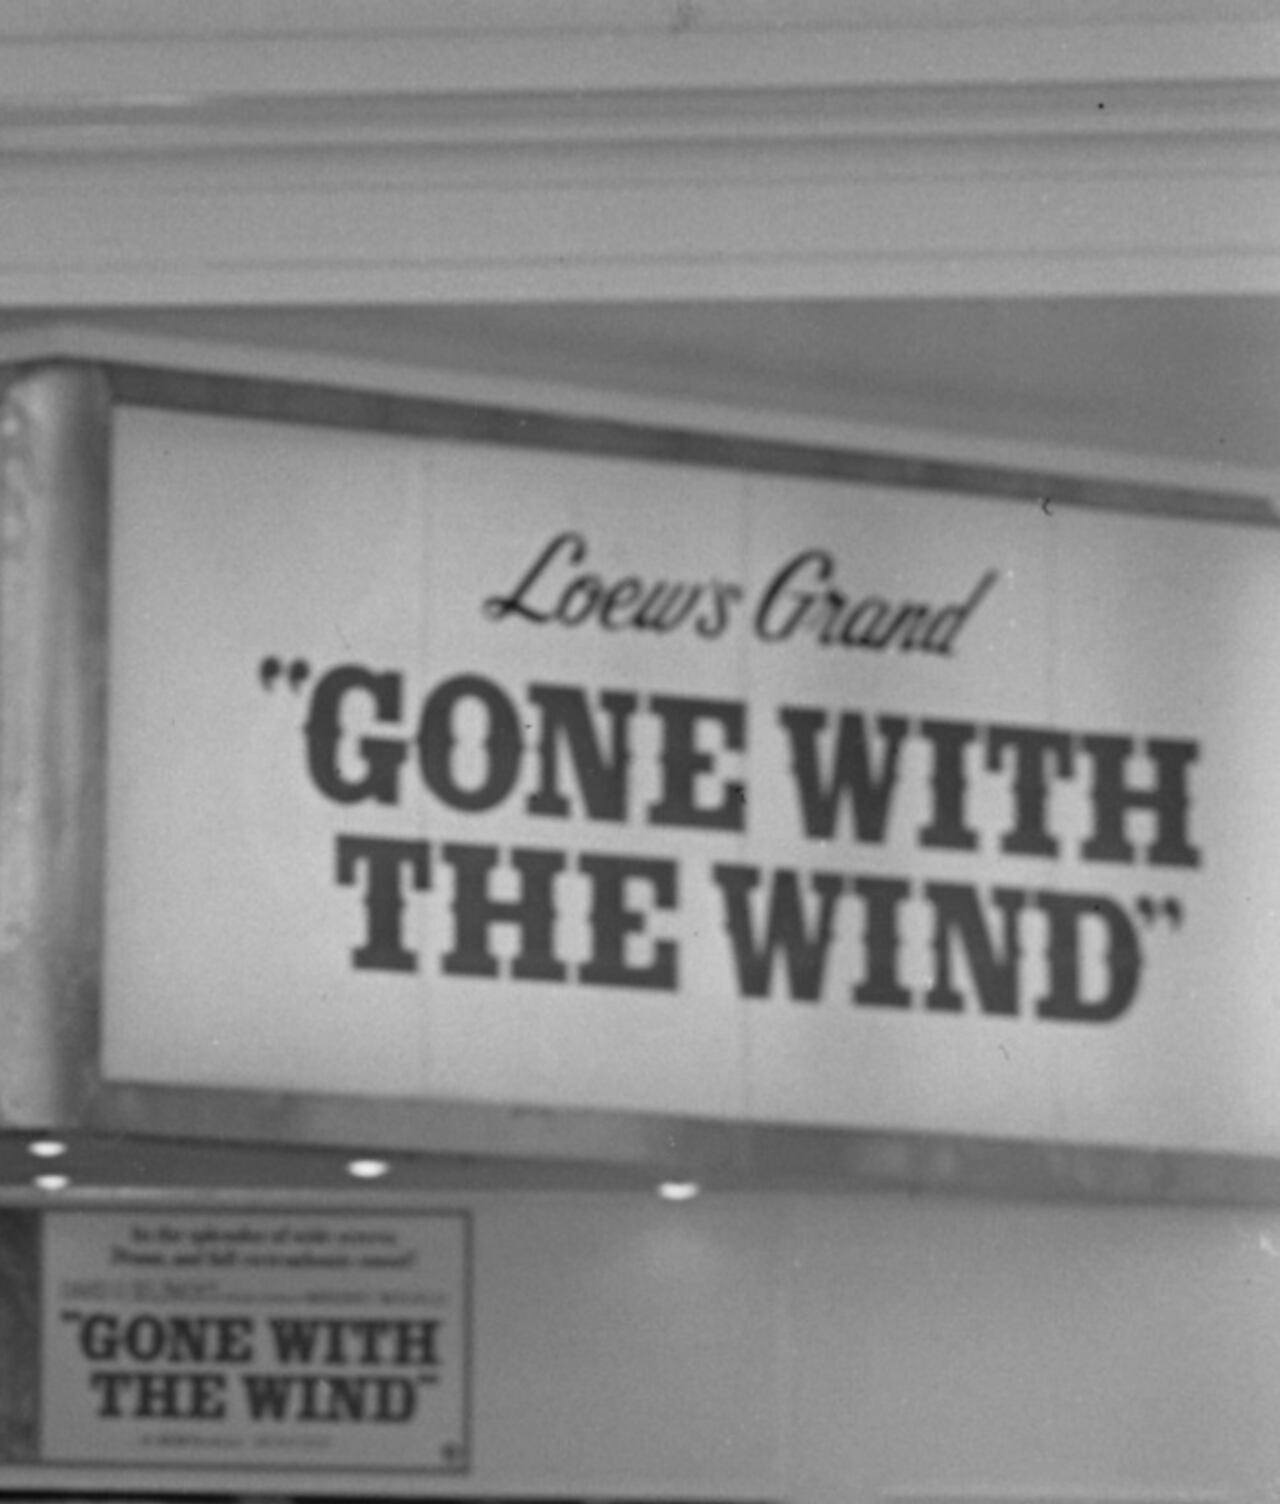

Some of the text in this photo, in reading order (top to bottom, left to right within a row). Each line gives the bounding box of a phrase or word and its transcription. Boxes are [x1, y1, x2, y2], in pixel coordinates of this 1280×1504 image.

[484, 532, 997, 658] Loew's Grand
[777, 704, 1203, 869] WITH
[334, 833, 679, 992] THE
[90, 1371, 227, 1420] THE
[269, 1317, 441, 1367] WITH
